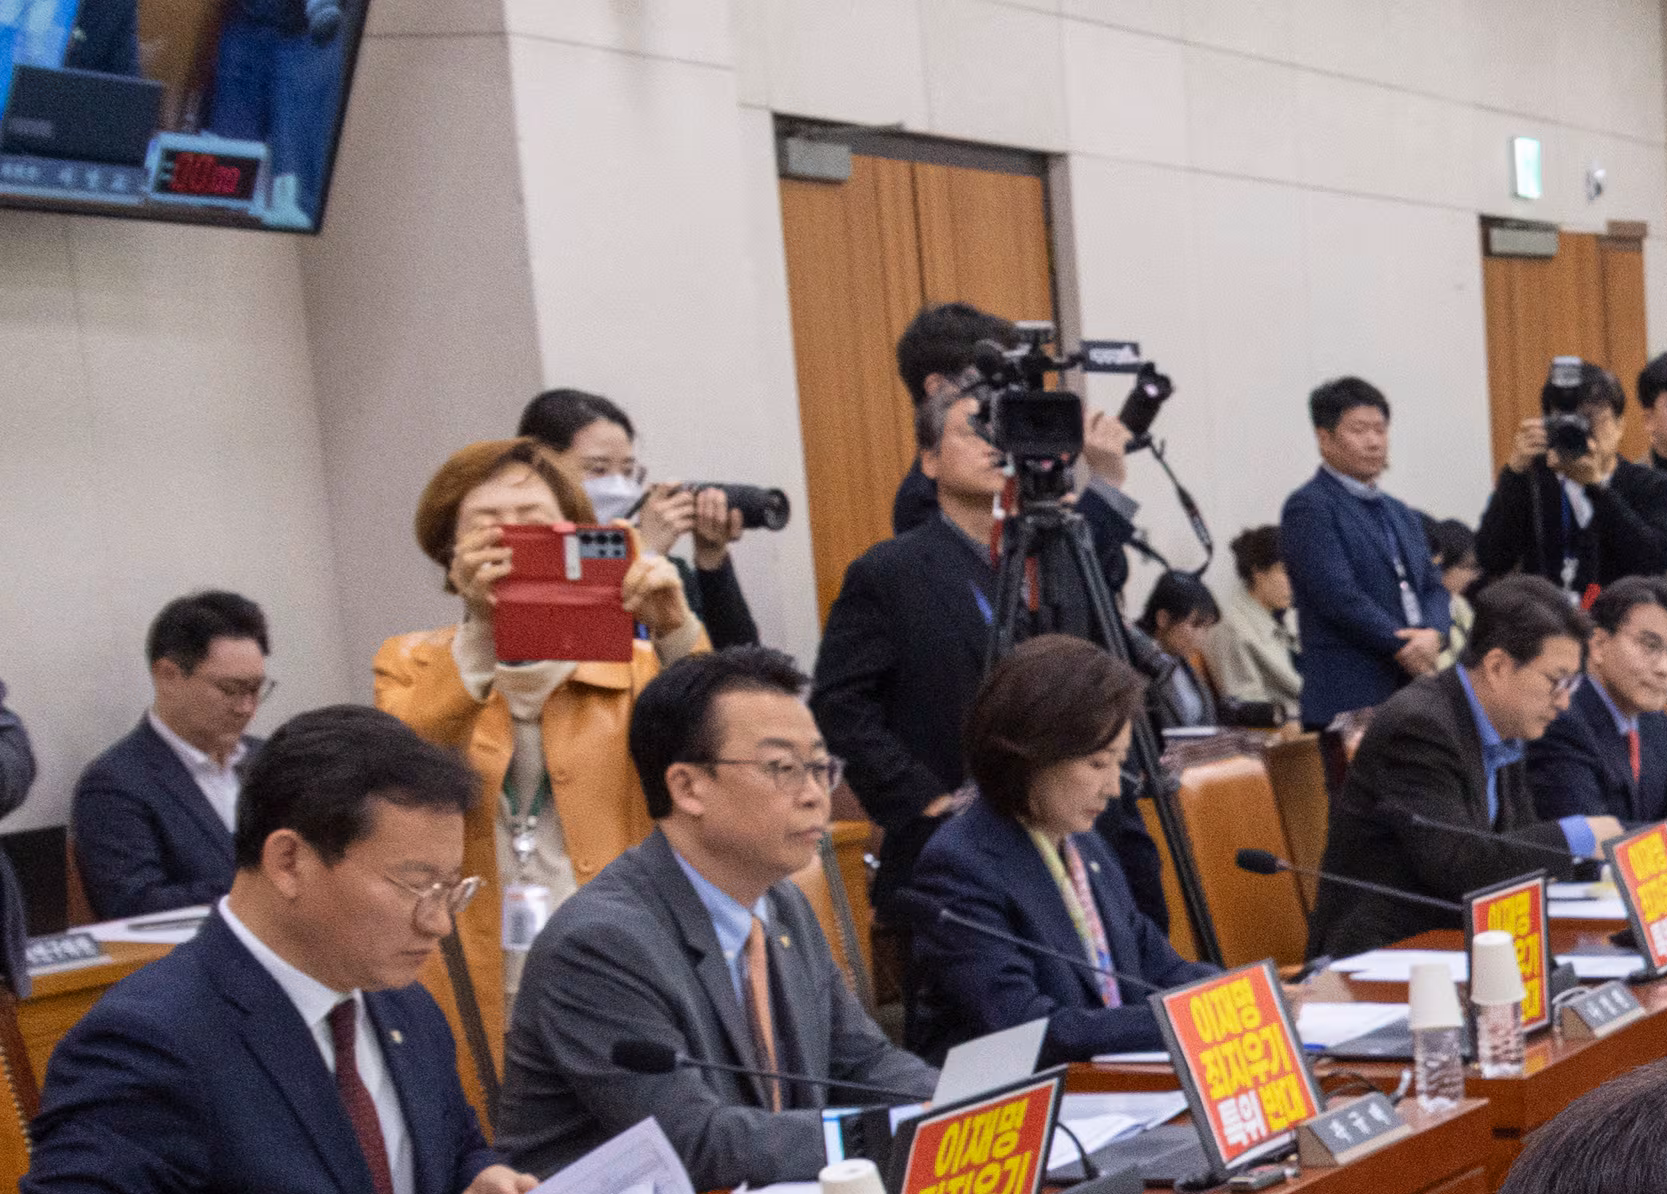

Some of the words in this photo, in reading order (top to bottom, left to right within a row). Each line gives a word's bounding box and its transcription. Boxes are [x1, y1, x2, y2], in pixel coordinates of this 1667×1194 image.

[1189, 976, 1262, 1044] 이재명
[1199, 1022, 1293, 1101] 죄지우기
[934, 1097, 1029, 1178] 이재명
